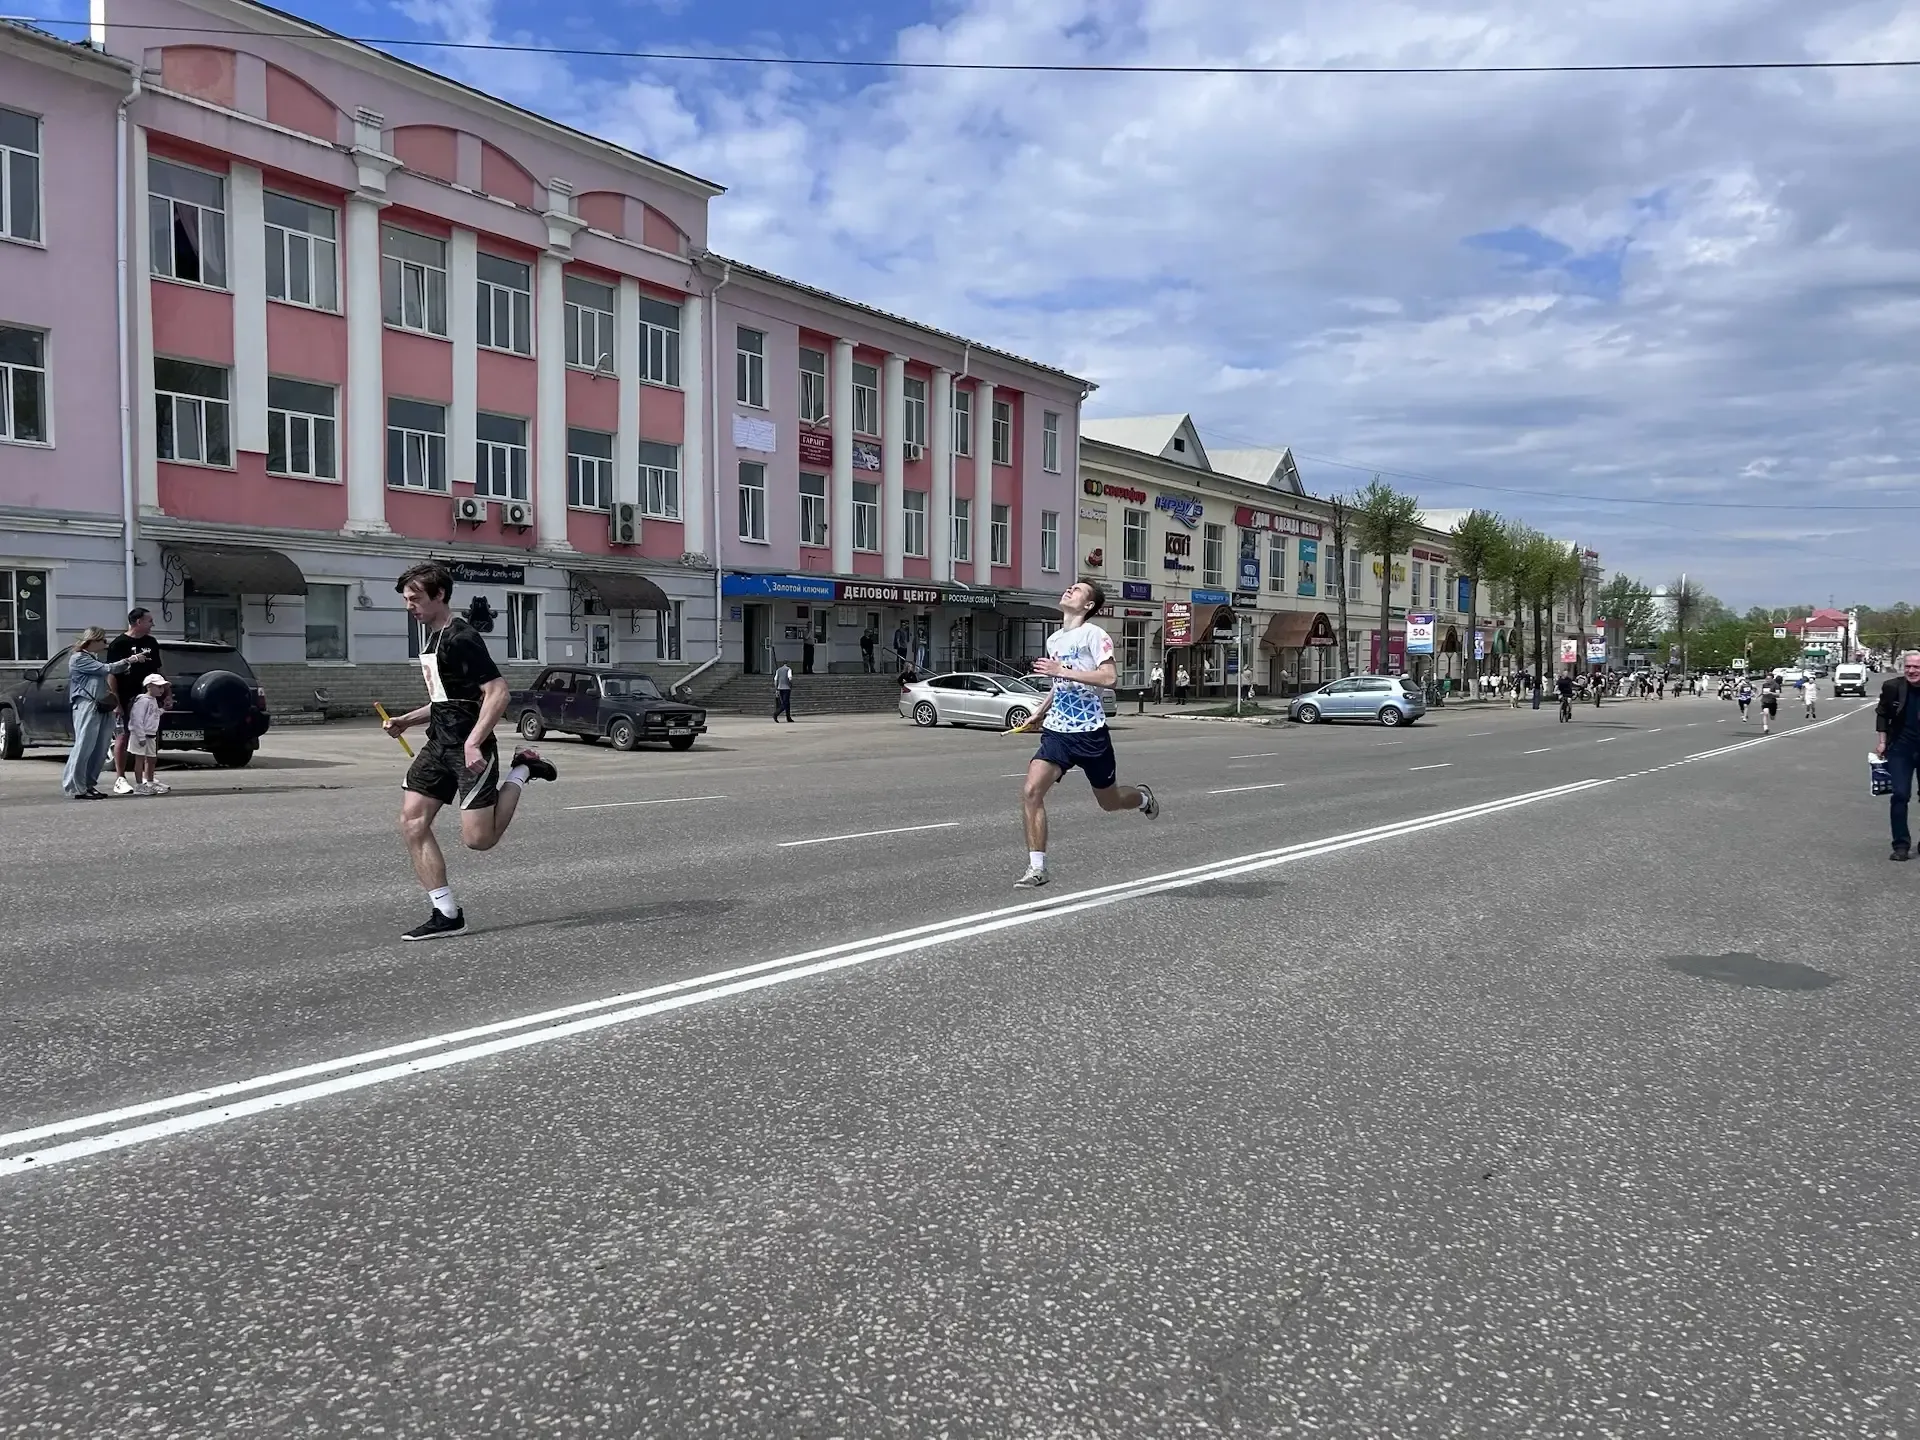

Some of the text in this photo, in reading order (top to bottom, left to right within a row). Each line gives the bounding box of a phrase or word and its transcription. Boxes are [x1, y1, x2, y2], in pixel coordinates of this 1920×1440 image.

[772, 581, 829, 594] Золотой ключик
[843, 585, 938, 603] ДЕЛОВОЙ ЦЕНТР
